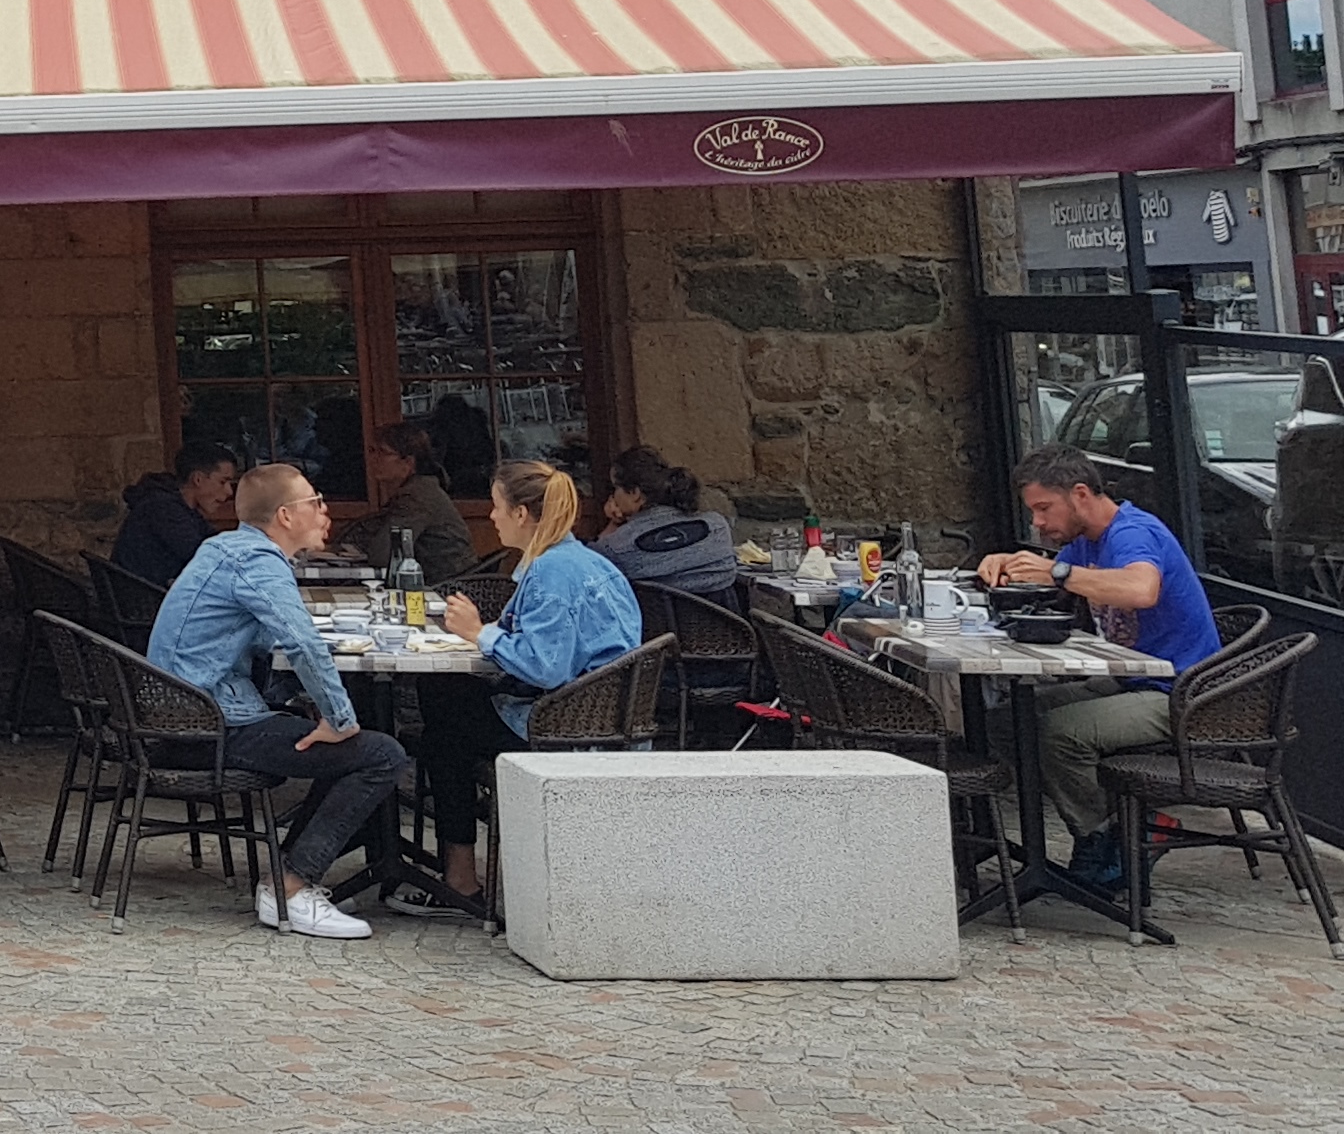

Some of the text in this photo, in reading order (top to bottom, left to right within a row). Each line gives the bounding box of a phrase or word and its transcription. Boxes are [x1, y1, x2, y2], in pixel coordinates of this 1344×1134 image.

[705, 118, 810, 150] Val de Rance
[785, 147, 811, 164] cidre
